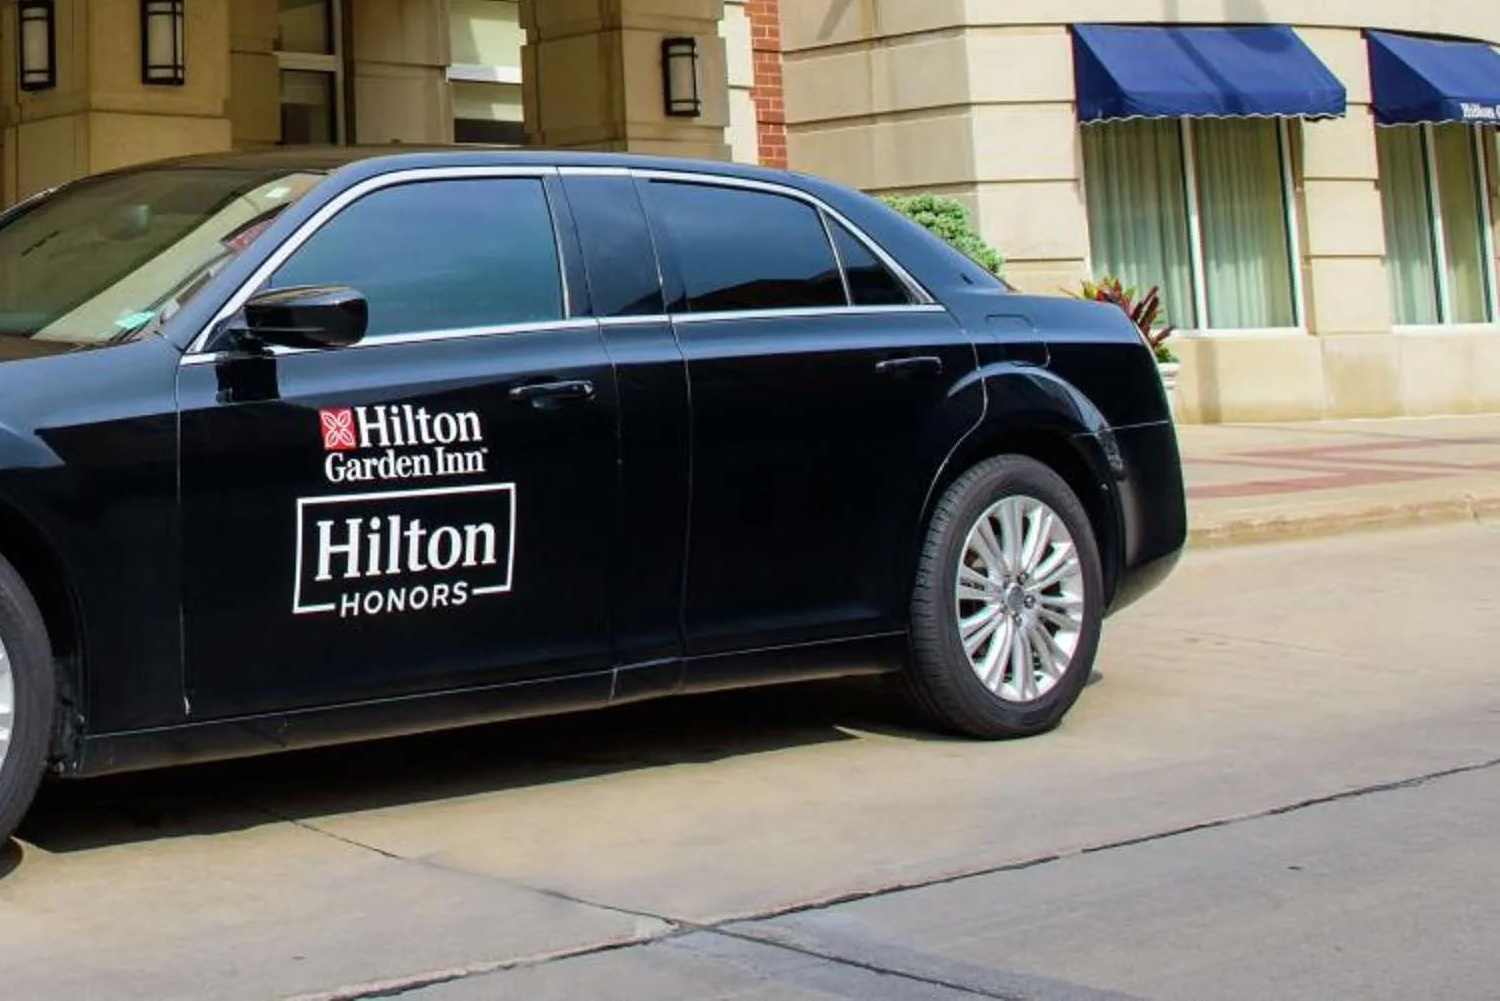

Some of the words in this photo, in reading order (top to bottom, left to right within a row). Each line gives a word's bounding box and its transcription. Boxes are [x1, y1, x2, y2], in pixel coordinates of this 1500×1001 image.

[355, 404, 483, 448] Hilton
[324, 449, 432, 483] Garden
[434, 446, 486, 474] Inn
[314, 514, 497, 581] Hilton
[340, 581, 469, 618] HONORS
